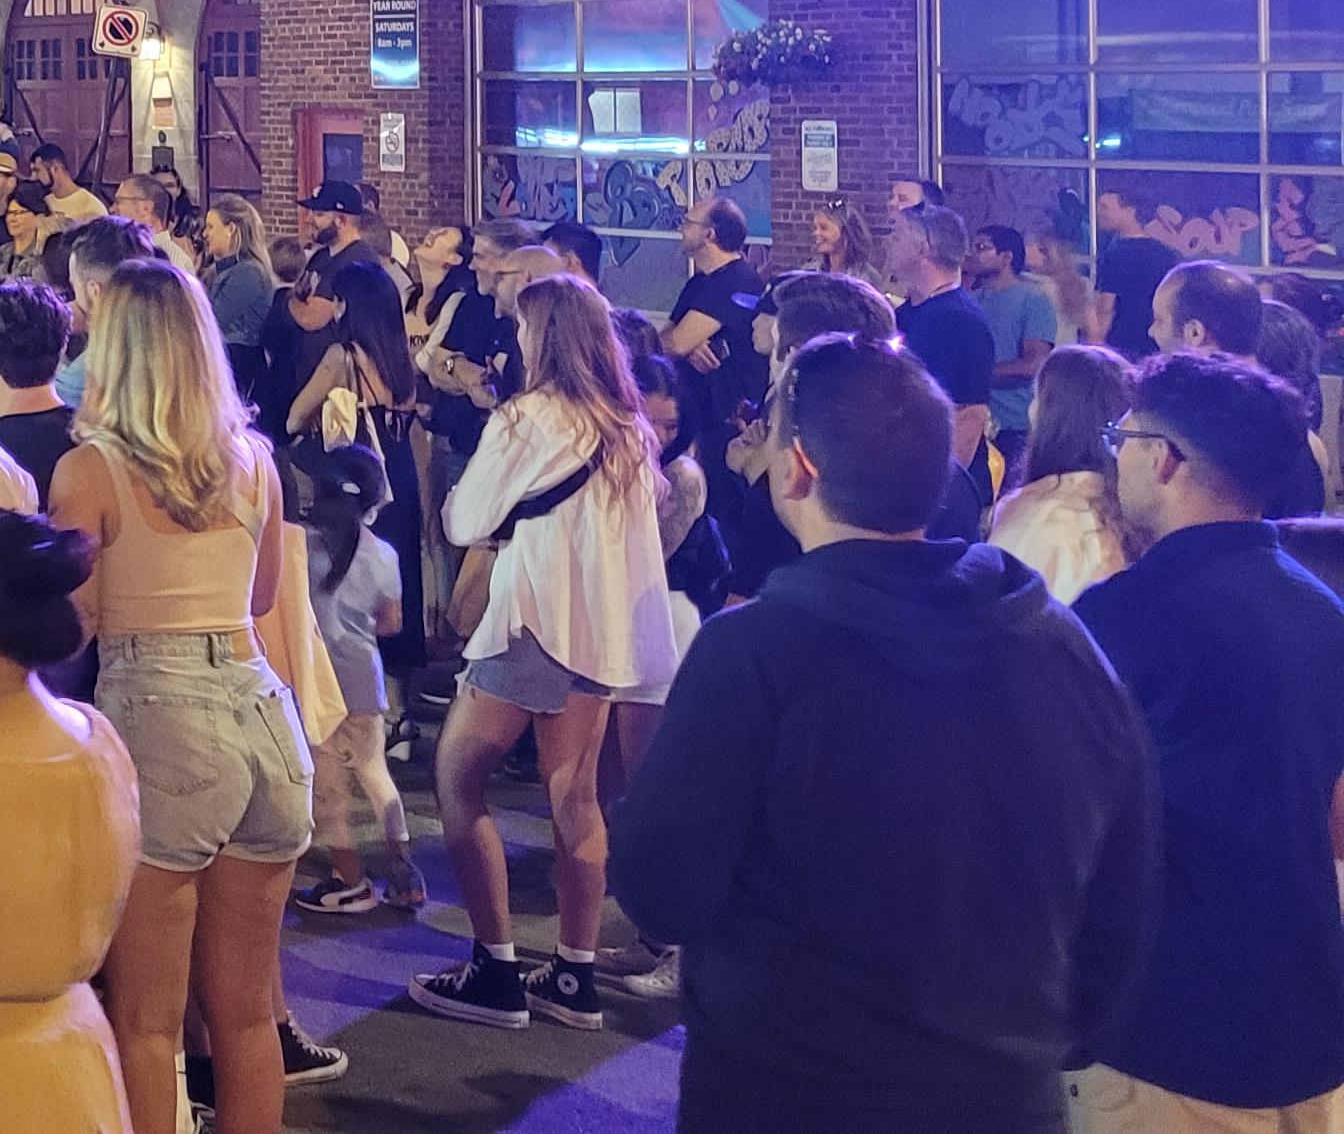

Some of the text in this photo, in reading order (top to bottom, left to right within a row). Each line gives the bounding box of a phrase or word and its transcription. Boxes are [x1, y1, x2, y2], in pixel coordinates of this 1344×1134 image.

[373, 0, 417, 13] YEAR ROUND
[375, 22, 415, 33] SATURDAYS
